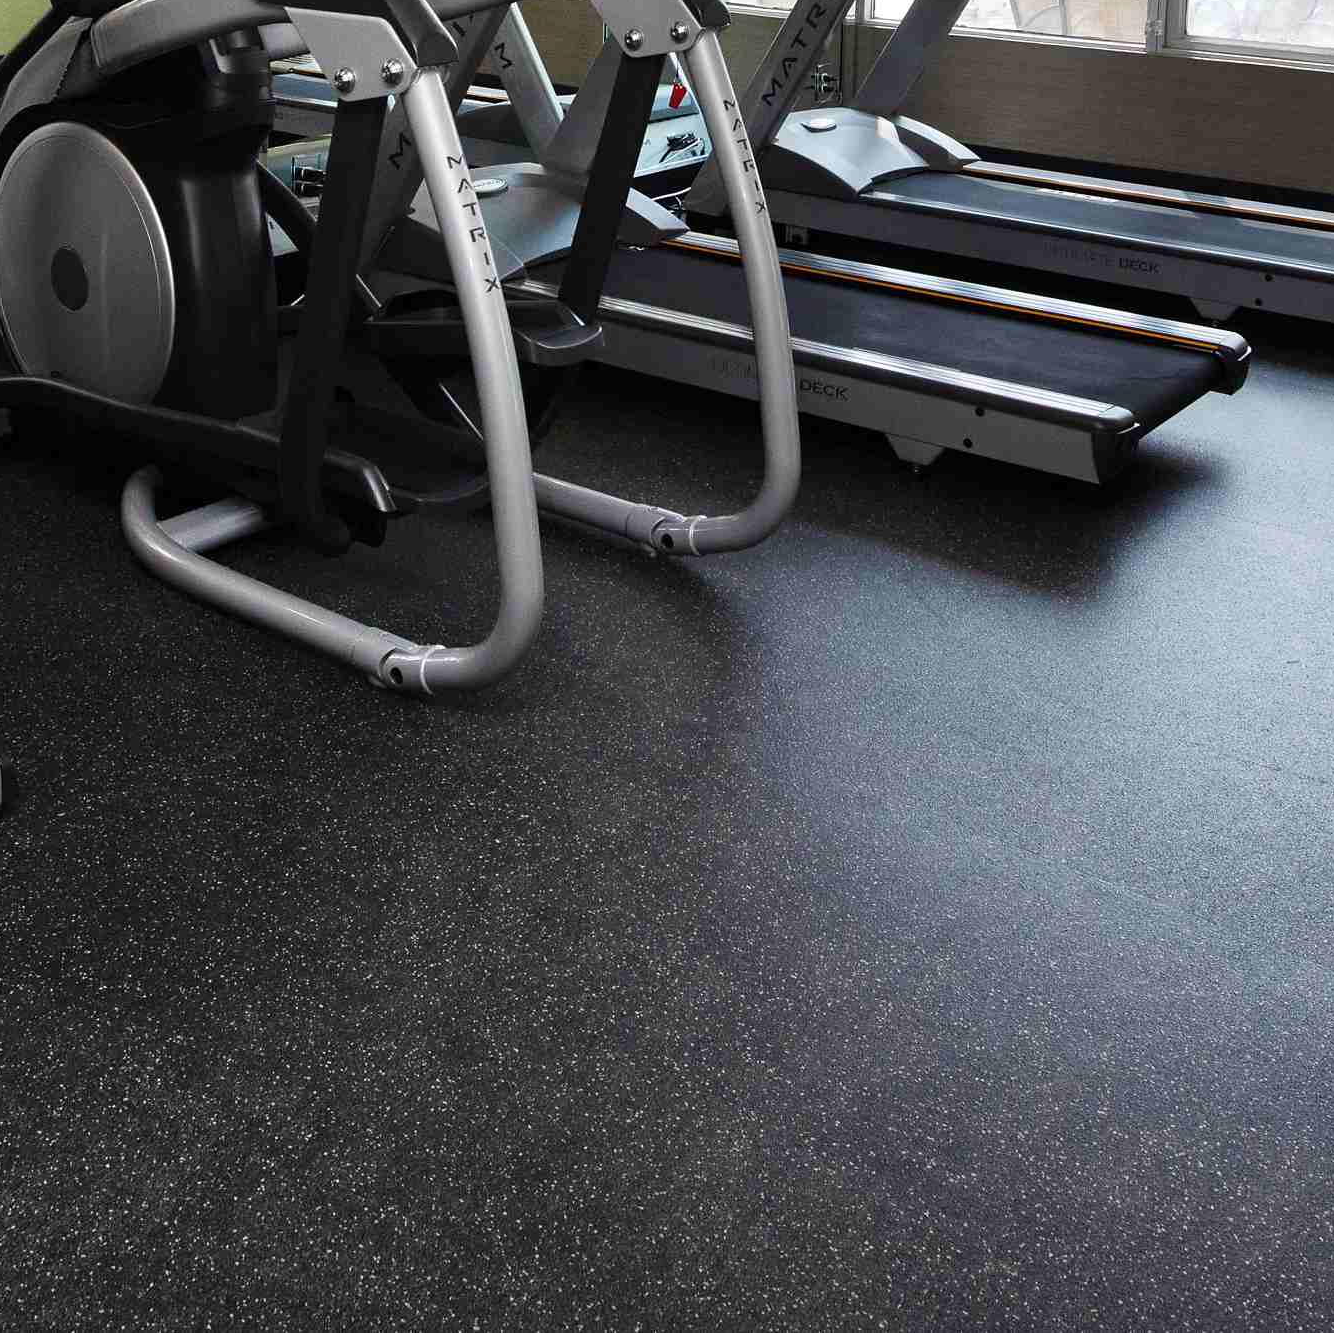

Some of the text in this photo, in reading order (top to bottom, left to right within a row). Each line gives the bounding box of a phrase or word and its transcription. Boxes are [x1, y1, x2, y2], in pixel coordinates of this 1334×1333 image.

[723, 99, 766, 214] MATRIX
[446, 154, 501, 293] MATRIX
[799, 379, 849, 400] DECK
